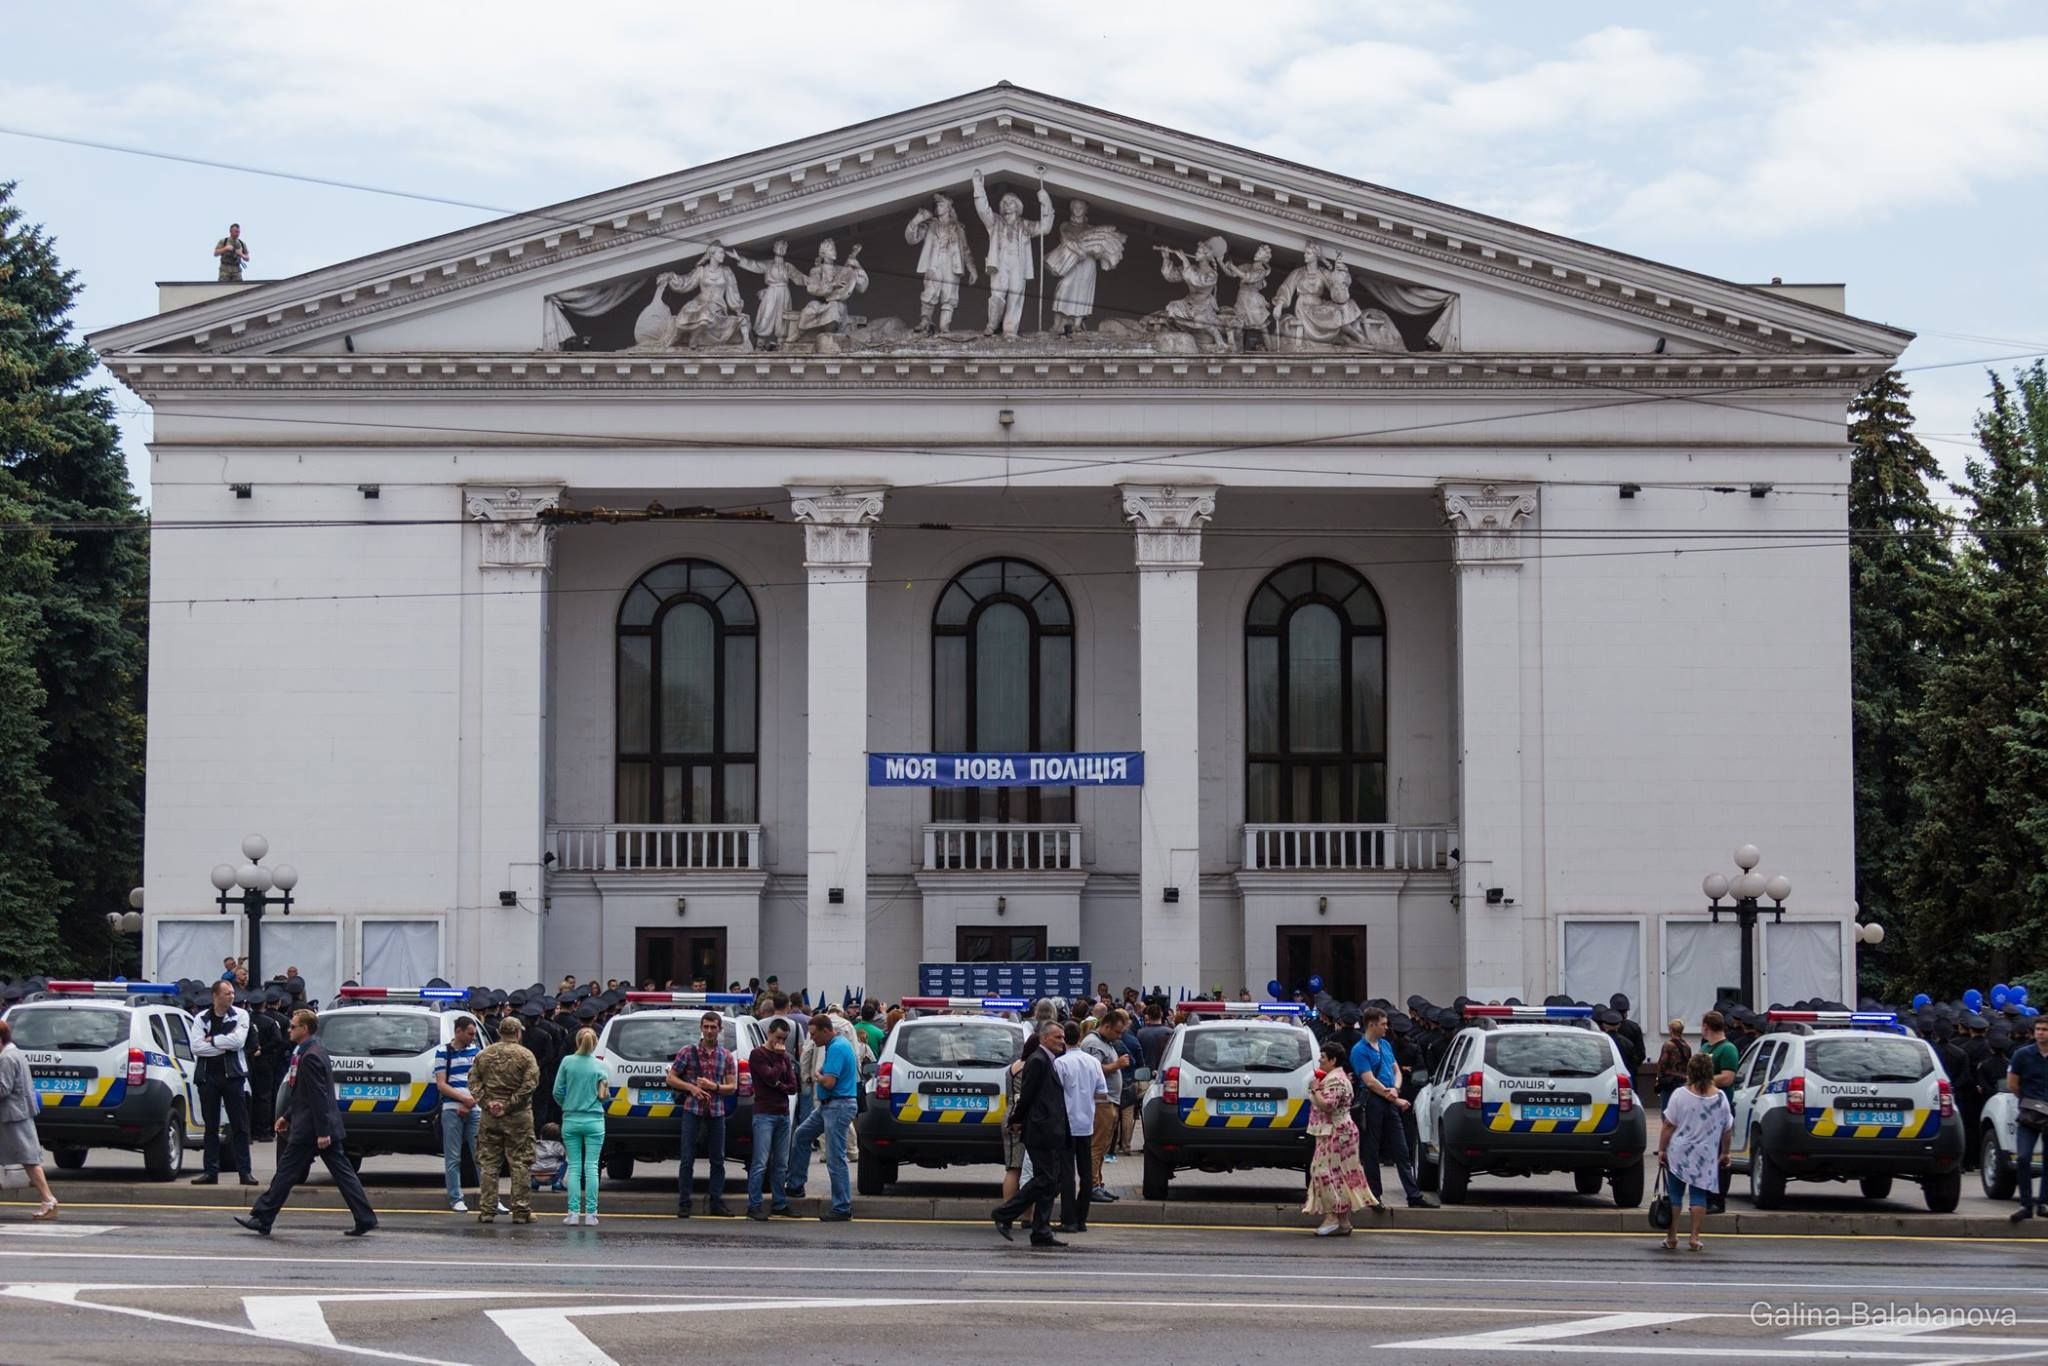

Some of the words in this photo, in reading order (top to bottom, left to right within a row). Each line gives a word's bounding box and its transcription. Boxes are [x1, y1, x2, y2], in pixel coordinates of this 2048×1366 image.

[886, 758, 937, 780] МОЯ
[954, 758, 1016, 780] НОВА
[1030, 758, 1127, 783] ПОЛІЦІЯ
[25, 1054, 52, 1063] ЛІЦІЯ
[330, 1060, 364, 1069] ОЛІЦІЯ
[617, 1065, 662, 1074] ПОЛІЦІЯ
[907, 1070, 953, 1080] ПОЛІЦІЯ
[1195, 1075, 1241, 1085] ПОЛІЦІЯ
[1499, 1080, 1545, 1089] ПОЛІЦІЯ
[54, 1081, 80, 1090] 2099
[1821, 1085, 1868, 1094] ПОЛІЦІЯ
[367, 1087, 393, 1096] 2201
[956, 1097, 982, 1107] 2166
[1245, 1102, 1271, 1111] 2148
[1549, 1107, 1575, 1117] 2045
